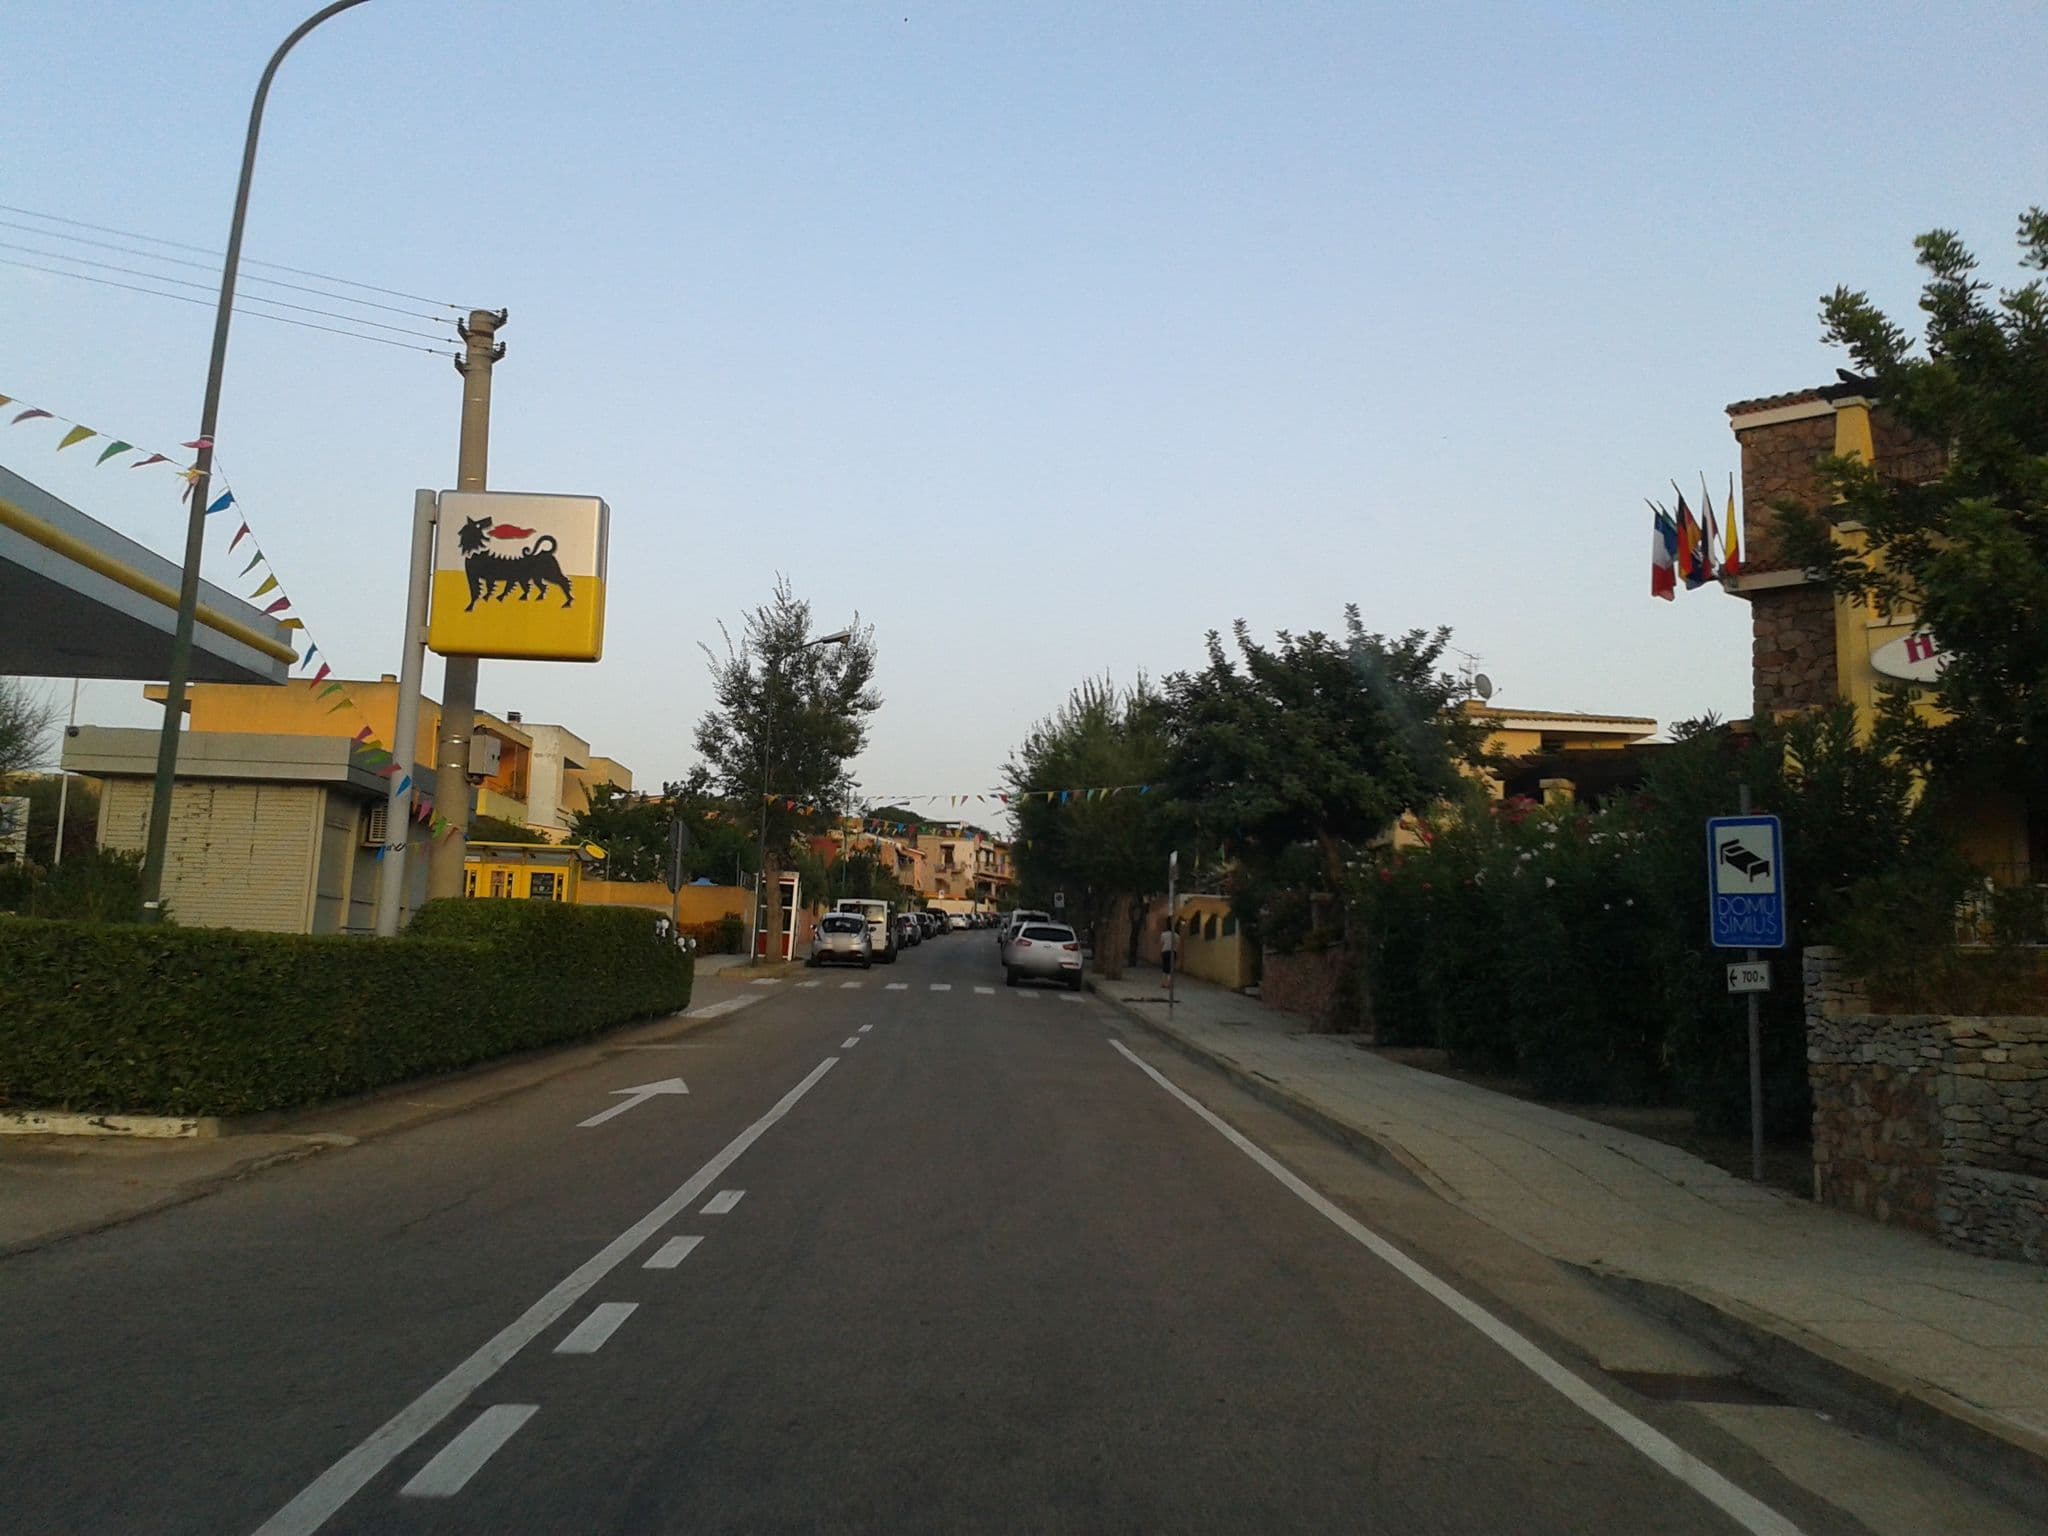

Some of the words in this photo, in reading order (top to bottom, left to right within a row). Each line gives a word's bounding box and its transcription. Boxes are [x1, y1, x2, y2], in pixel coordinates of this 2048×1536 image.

[1718, 896, 1776, 916] DOMU
[1719, 915, 1777, 935] SIMIUS
[1742, 970, 1758, 983] 700
